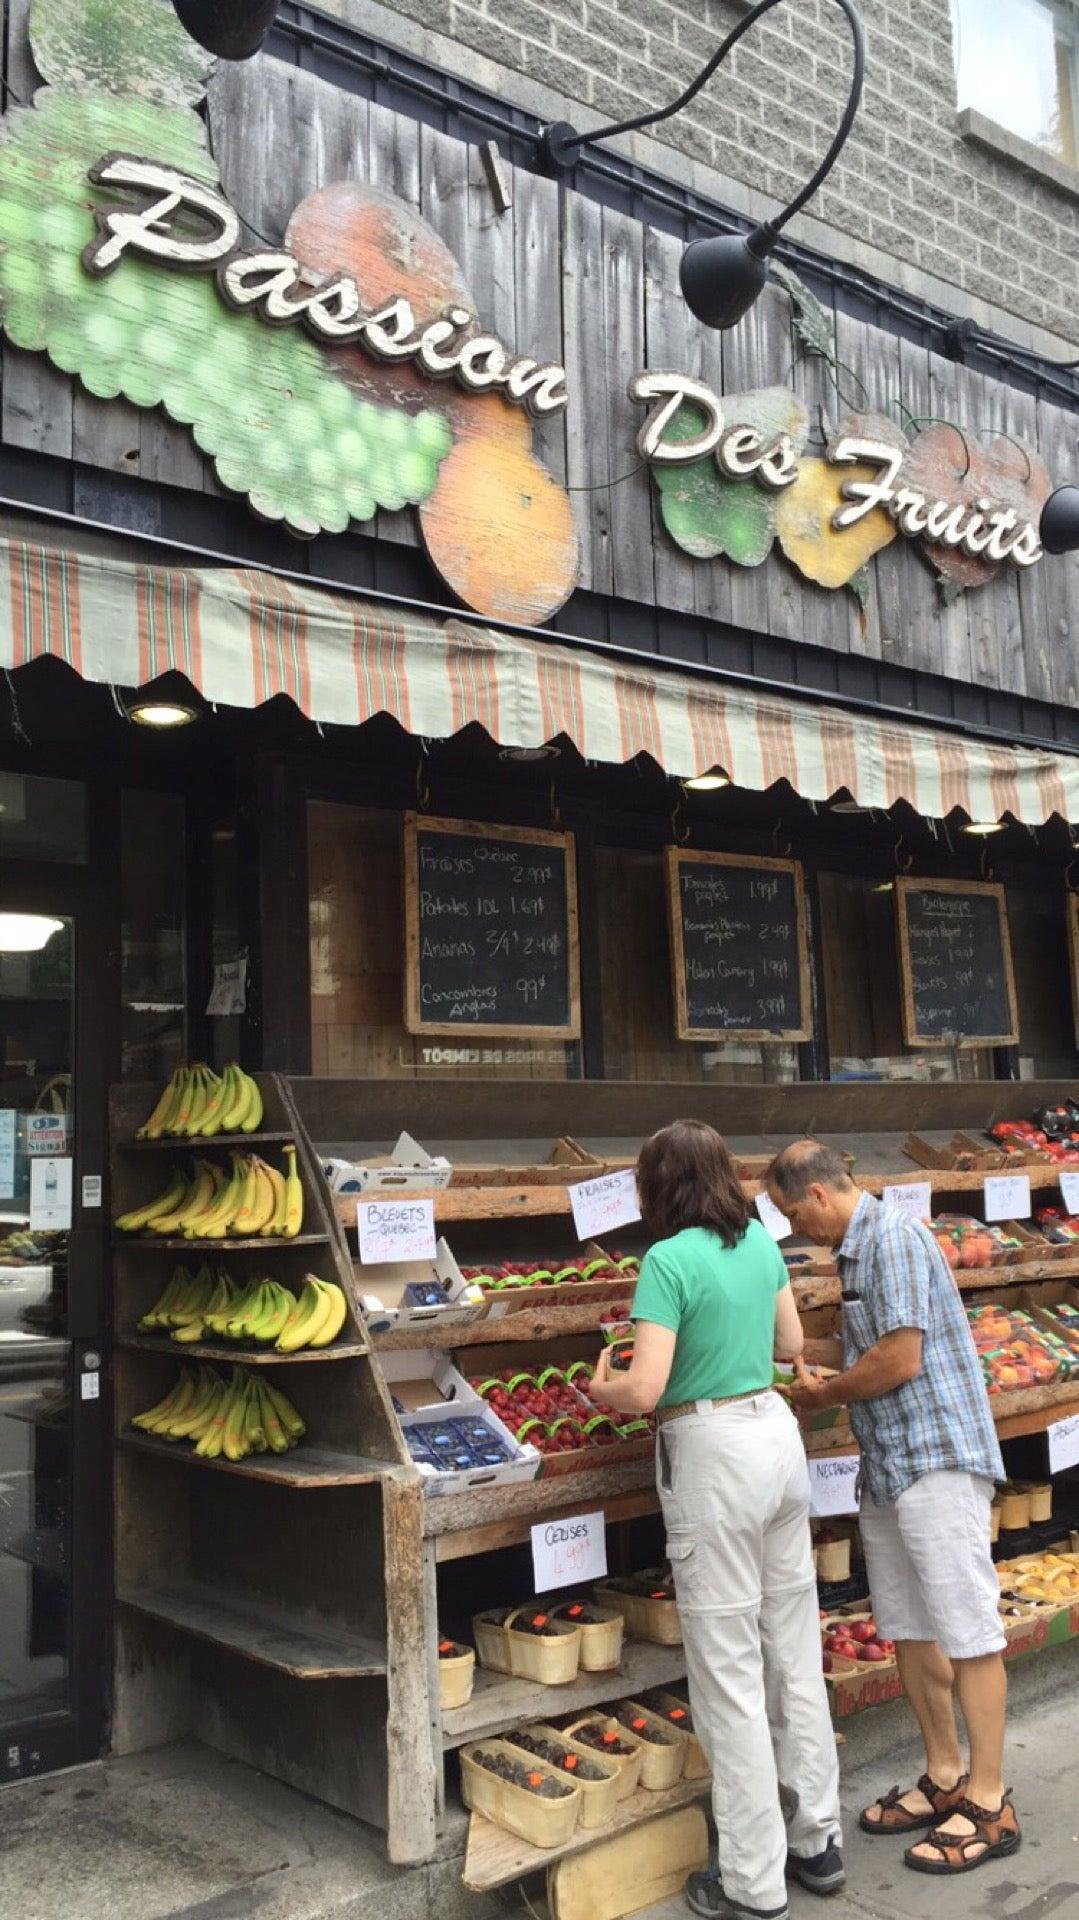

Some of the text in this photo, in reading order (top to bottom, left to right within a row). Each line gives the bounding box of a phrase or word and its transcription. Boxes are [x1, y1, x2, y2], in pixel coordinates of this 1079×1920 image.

[89, 154, 1043, 567] Passion Des Fruits
[367, 1204, 425, 1225] BLEUETS
